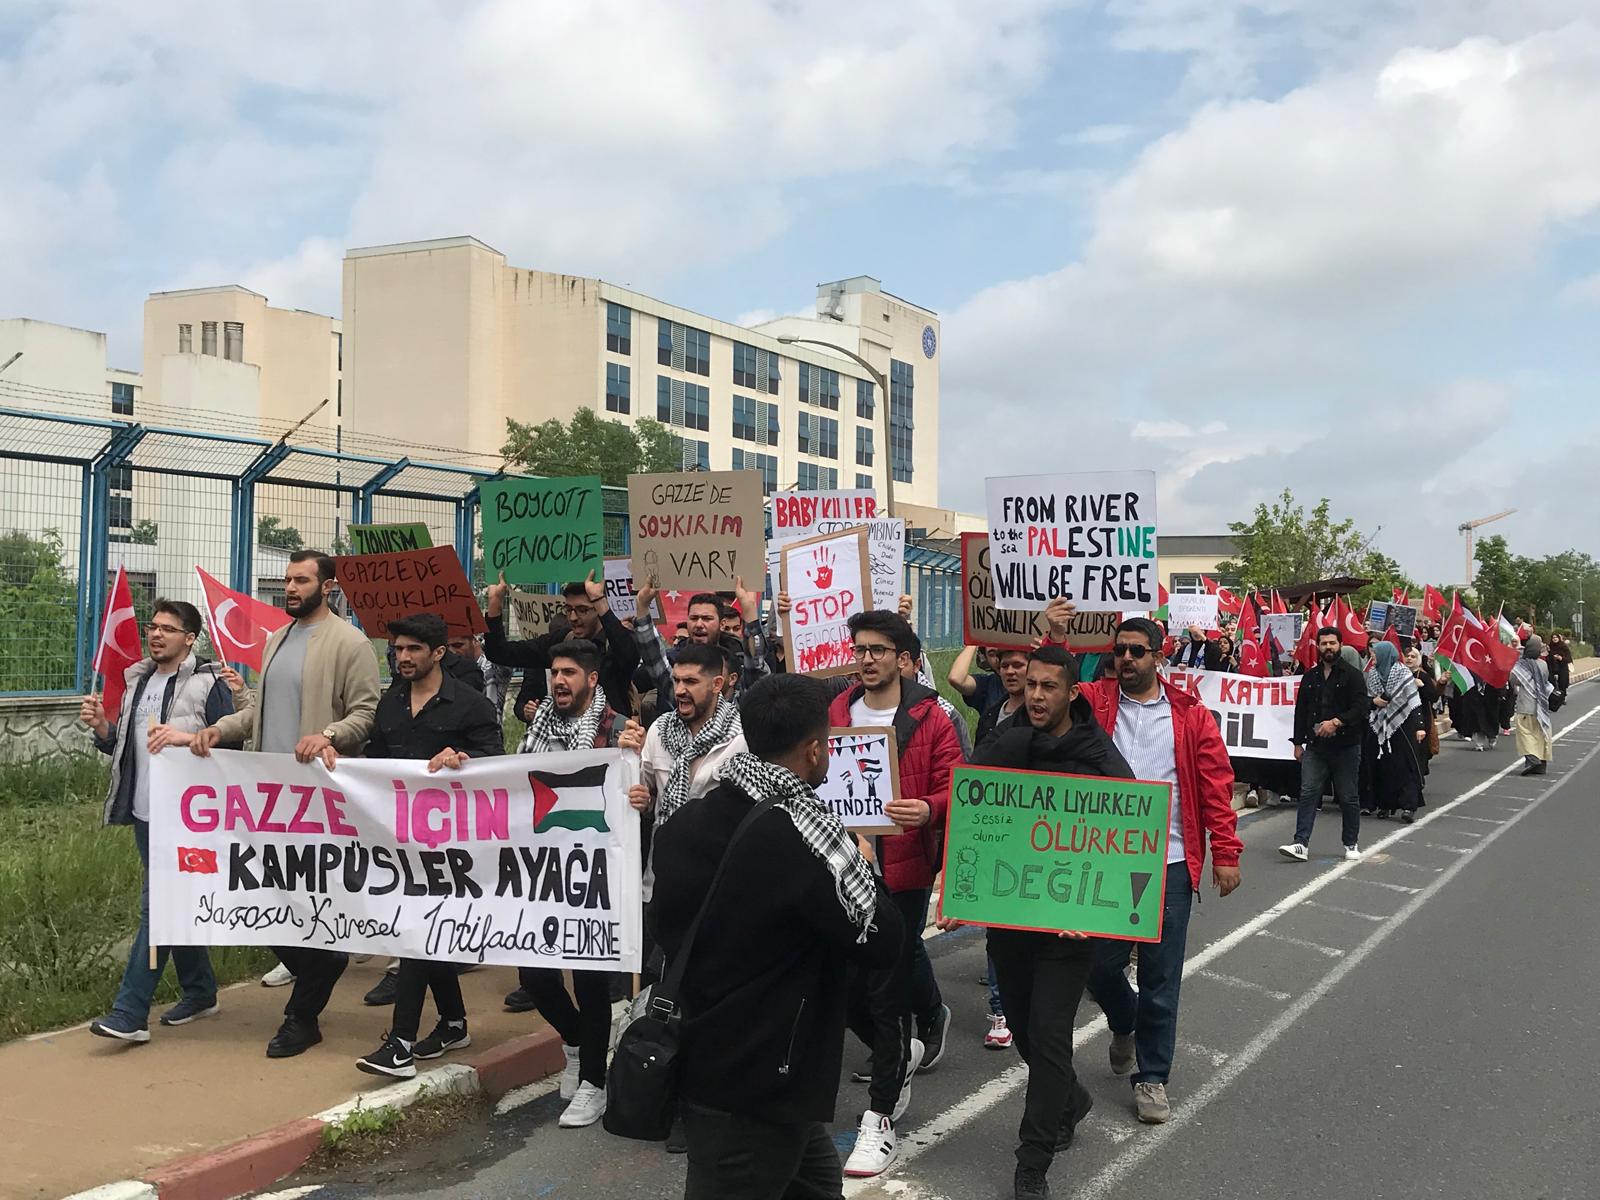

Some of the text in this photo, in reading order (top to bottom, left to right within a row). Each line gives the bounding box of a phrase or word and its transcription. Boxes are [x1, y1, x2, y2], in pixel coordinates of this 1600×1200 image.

[494, 487, 593, 523] BOYCOTT
[651, 480, 733, 506] GAZZE'DE
[1003, 492, 1140, 524] FROM RIVER
[638, 514, 743, 539] SOYKIRIM
[775, 495, 819, 528] BABY
[857, 520, 901, 541] MBING
[993, 525, 1156, 558] to the PALESTINE
[1000, 543, 1018, 554] sea
[492, 531, 599, 570] GENOCIDE
[995, 562, 1152, 603] WILL BE FREE
[795, 590, 854, 626] STOP
[1211, 709, 1269, 749] İL
[956, 778, 1057, 813] ÇOCUKLAR
[180, 779, 510, 849] GAZZE İÇİN
[1030, 814, 1160, 855] ÖLÜRKEN
[228, 840, 612, 911] KAMPÜSLER AYAĞA
[562, 918, 621, 957] EDİRNE
